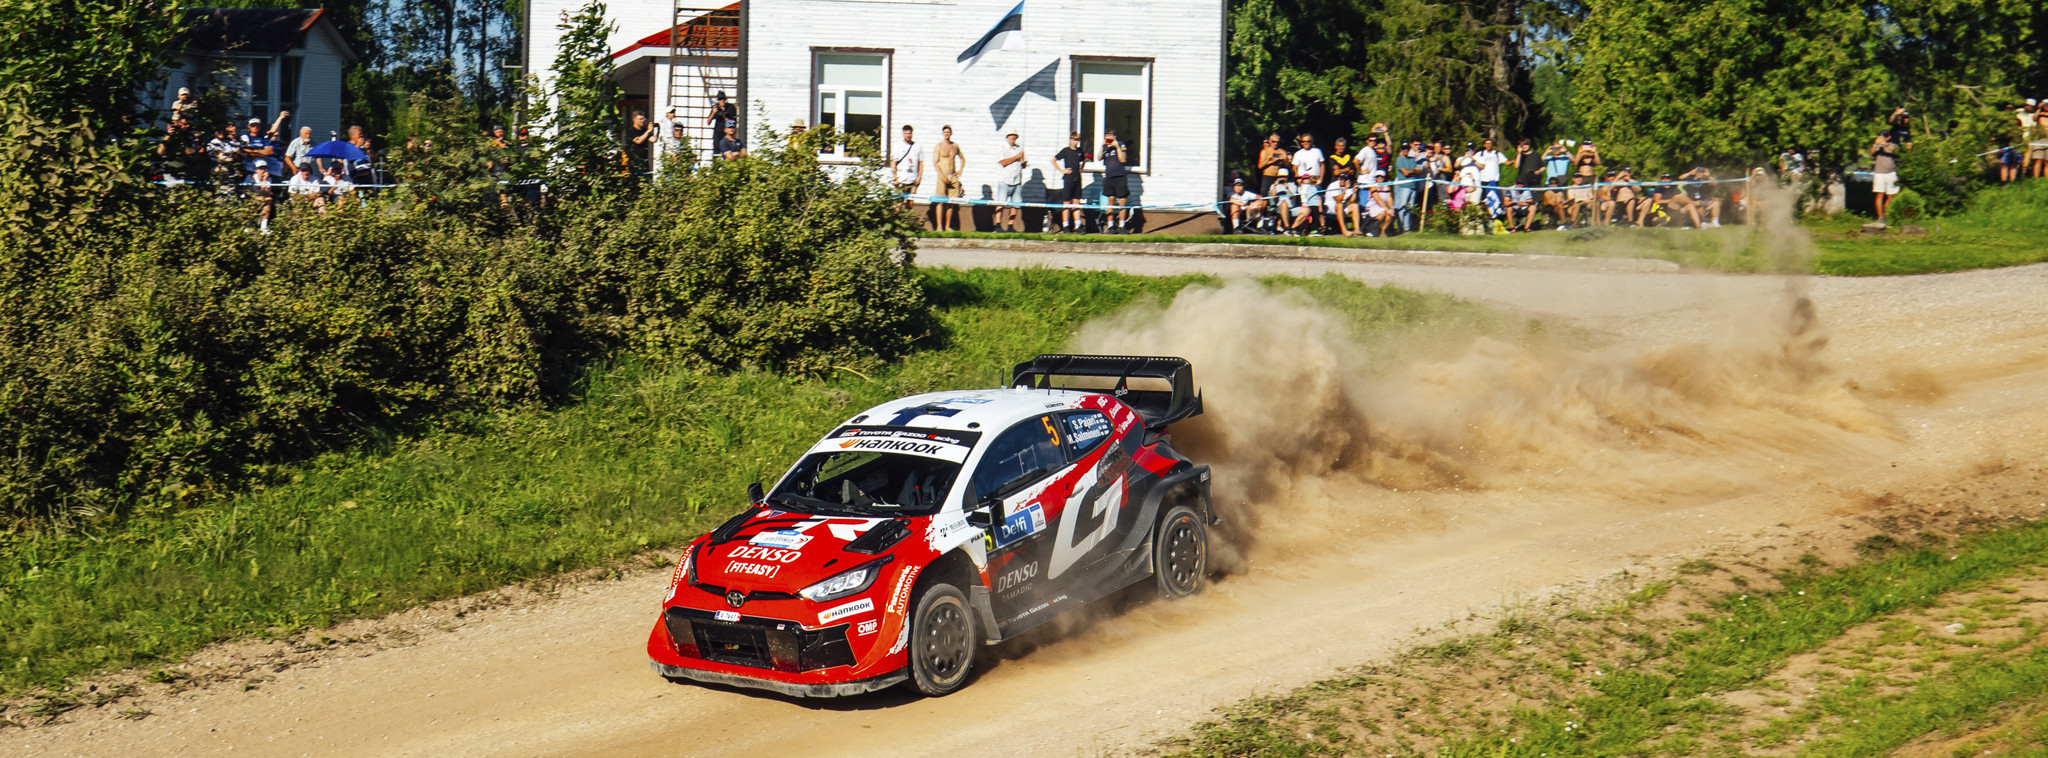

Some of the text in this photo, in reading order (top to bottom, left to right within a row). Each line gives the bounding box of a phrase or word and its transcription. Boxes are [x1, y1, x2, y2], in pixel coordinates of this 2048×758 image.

[1041, 416, 1060, 446] 5
[970, 532, 985, 544] PIAA
[1001, 515, 1027, 540] Delfi
[726, 545, 802, 563] DENSO
[887, 565, 913, 613] Panasonic
[997, 560, 1039, 594] DENSO
[896, 565, 922, 616] AUTOMOTIVE
[1002, 583, 1033, 602] TAMADIC
[857, 621, 878, 634] OMP
